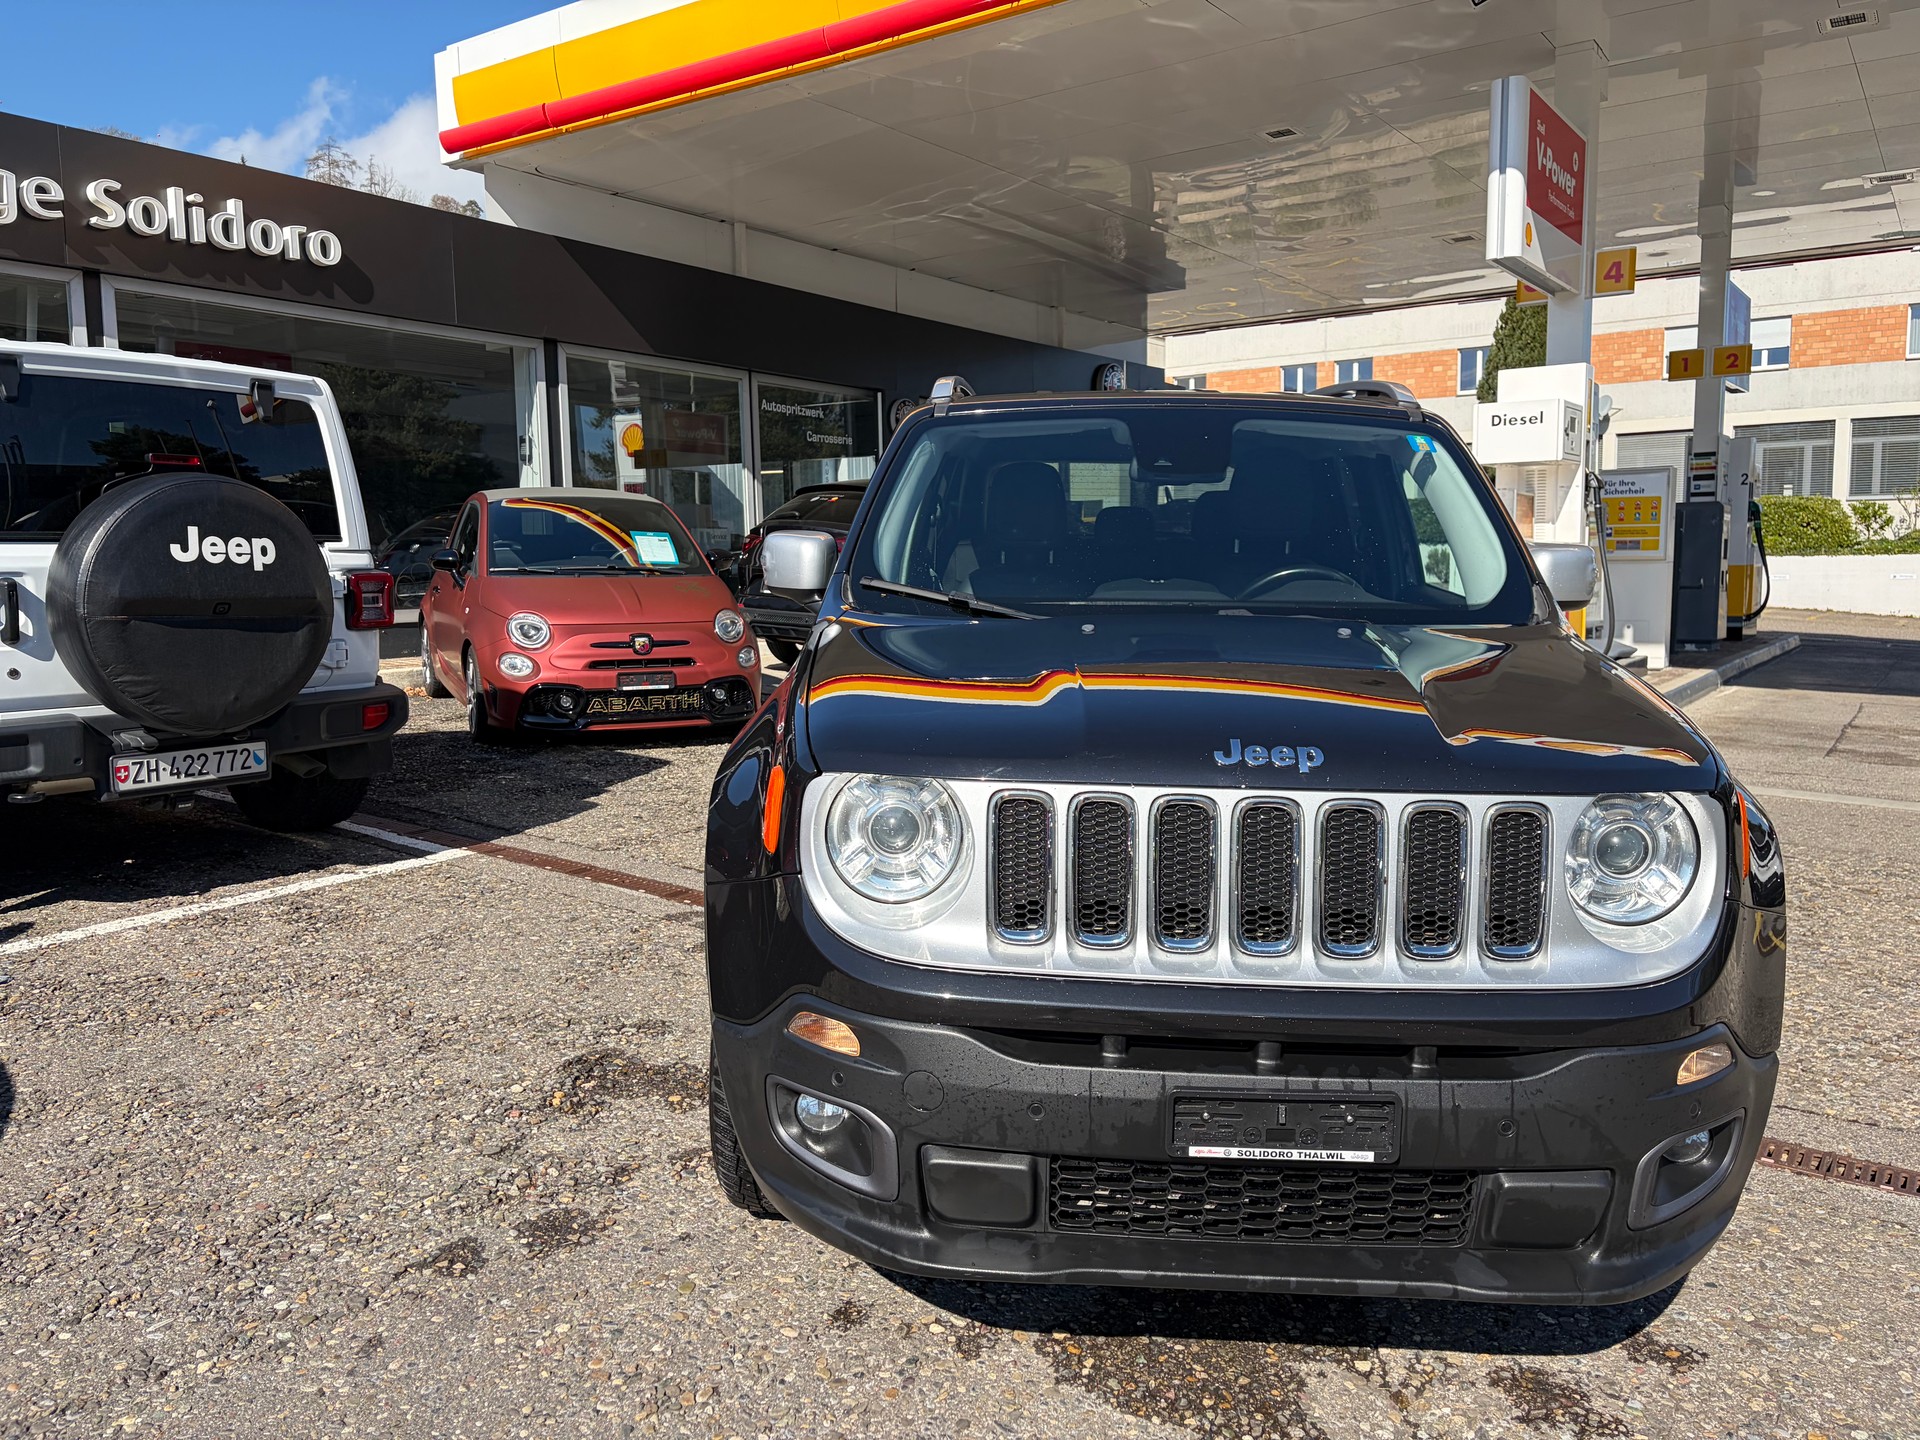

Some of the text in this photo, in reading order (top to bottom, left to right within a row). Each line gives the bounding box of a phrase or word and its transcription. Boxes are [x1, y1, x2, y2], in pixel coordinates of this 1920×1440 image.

[1536, 137, 1576, 198] V-Power
[85, 177, 343, 267] Solidoro
[1603, 260, 1625, 284] 4
[1681, 353, 1739, 373] 1 2
[761, 399, 825, 419] Autospritzwerk
[1491, 411, 1544, 427] Diesel
[806, 430, 853, 445] Carrosserie
[1740, 472, 1749, 486] 2
[1604, 487, 1645, 496] Sicherheit
[169, 525, 276, 571] Jeep
[587, 693, 700, 714] ABARTH
[1213, 738, 1325, 774] Jeep
[1236, 1149, 1294, 1159] SOLIDORO
[1297, 1151, 1346, 1160] THALWIL
